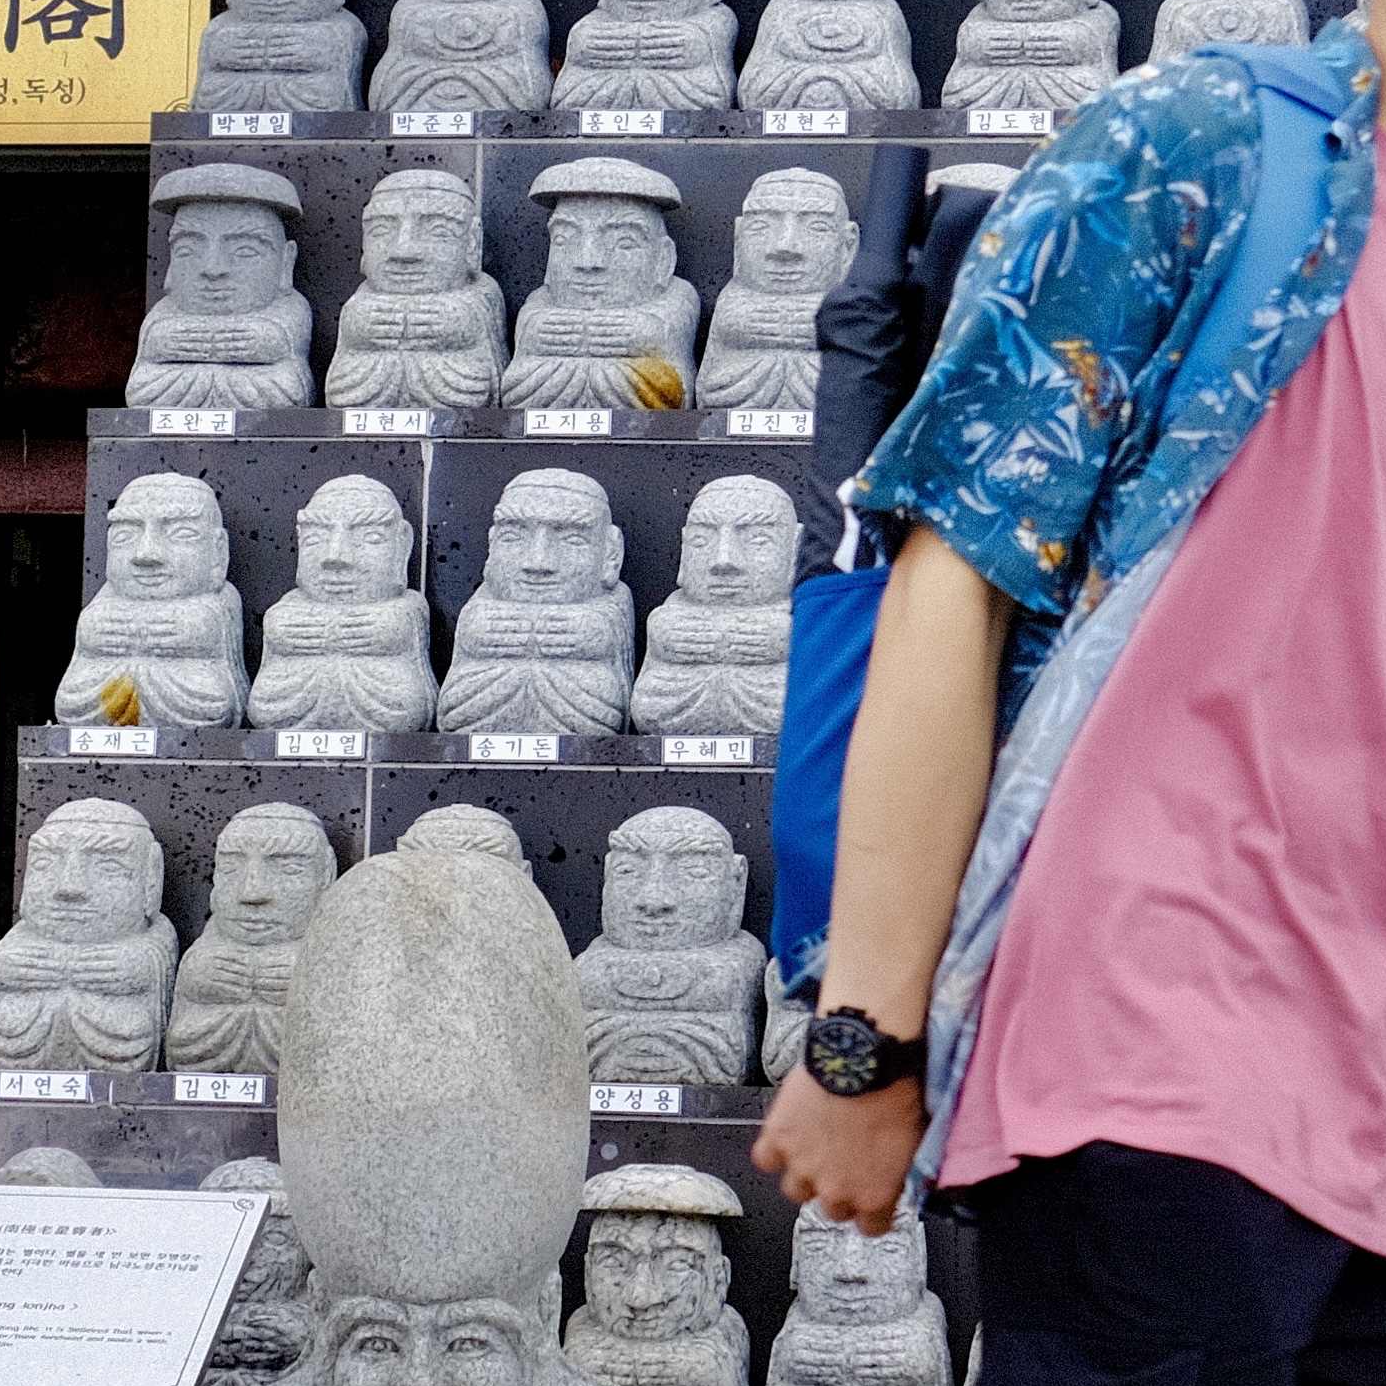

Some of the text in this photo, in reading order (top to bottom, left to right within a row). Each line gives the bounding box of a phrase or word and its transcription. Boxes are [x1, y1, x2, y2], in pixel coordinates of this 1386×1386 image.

[216, 115, 285, 134] 박병일
[396, 114, 468, 133] 박준우
[586, 113, 657, 132] 홍인숙
[770, 112, 842, 132] 정현수
[975, 112, 1046, 132] 김도현
[156, 412, 229, 432] 조완균
[351, 412, 422, 432] 김현서
[531, 412, 605, 433] 고지용
[736, 413, 808, 433] 김진경
[75, 731, 150, 752] 송재근
[285, 733, 357, 756] 김인열
[476, 738, 552, 759] 송기돈
[669, 739, 746, 761] 우혜민
[5, 1074, 82, 1097] 서연숙
[181, 1077, 258, 1100] 김안석
[595, 1089, 673, 1110] 양성용
